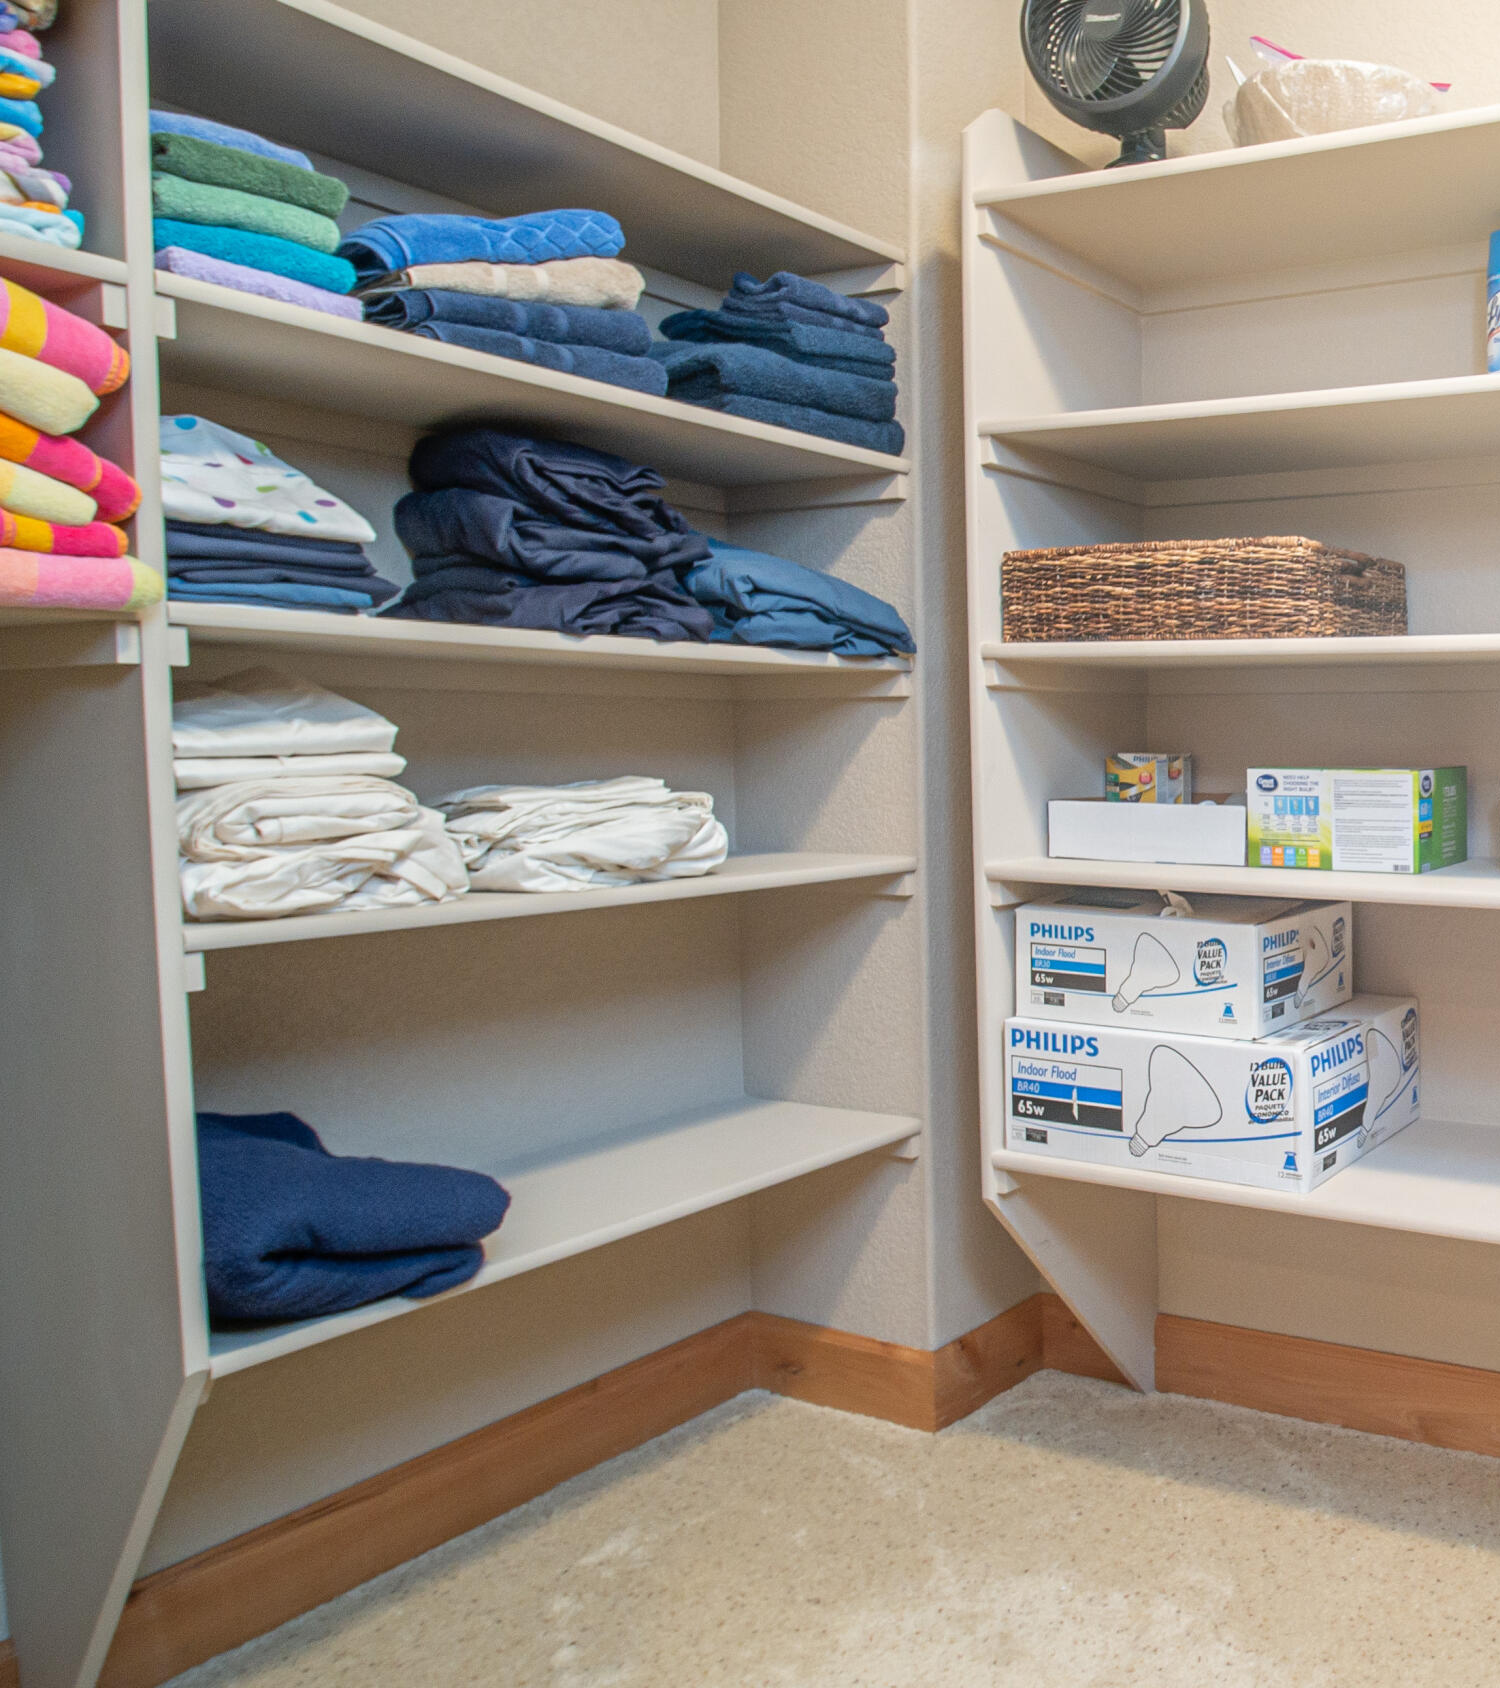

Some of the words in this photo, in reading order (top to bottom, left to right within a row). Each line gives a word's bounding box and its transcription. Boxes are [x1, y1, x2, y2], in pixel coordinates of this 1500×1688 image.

[1030, 922, 1095, 942] PHILIPS
[1034, 946, 1056, 957] Indoor
[1058, 948, 1076, 959] Flood
[1198, 948, 1223, 960] VALUE
[1200, 960, 1222, 971] PACK
[1034, 973, 1054, 985] 65w
[1011, 1028, 1100, 1057] PHILIPS
[1310, 1033, 1364, 1078] PHILIPS
[1017, 1061, 1048, 1077] Indoor
[1051, 1065, 1077, 1081] Flood
[1017, 1081, 1040, 1094] BR40
[1251, 1073, 1288, 1087] VALUE
[1317, 1083, 1341, 1103] Interior
[1341, 1072, 1361, 1091] Difuso
[1254, 1088, 1286, 1103] PACK
[1017, 1099, 1045, 1116] 65w
[1317, 1126, 1337, 1146] 65w
